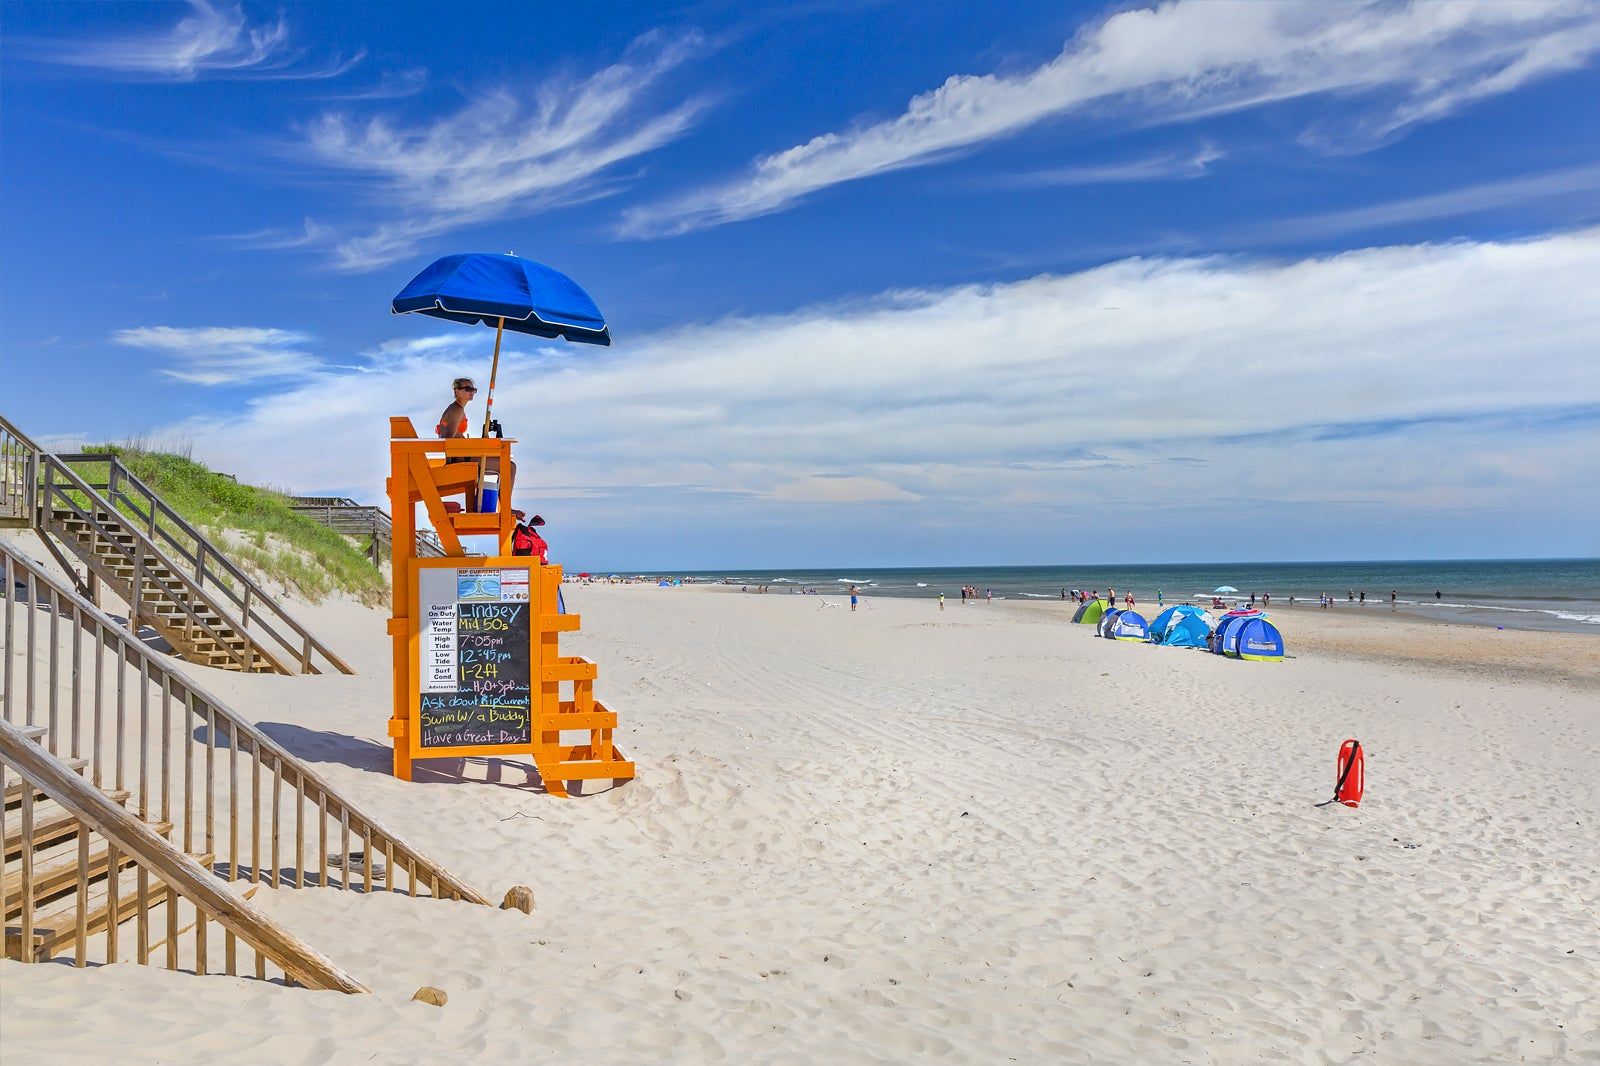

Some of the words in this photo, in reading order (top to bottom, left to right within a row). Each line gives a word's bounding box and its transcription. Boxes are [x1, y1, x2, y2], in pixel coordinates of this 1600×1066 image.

[458, 604, 521, 623] Lindsey
[458, 618, 480, 630] Mid
[483, 618, 508, 631] 50s
[421, 696, 445, 711] Ask
[449, 696, 479, 706] about
[421, 712, 454, 726] Swim
[490, 709, 530, 728] Buddy!
[424, 730, 451, 746] Have
[464, 729, 494, 742] Great
[500, 730, 526, 743] Day!
